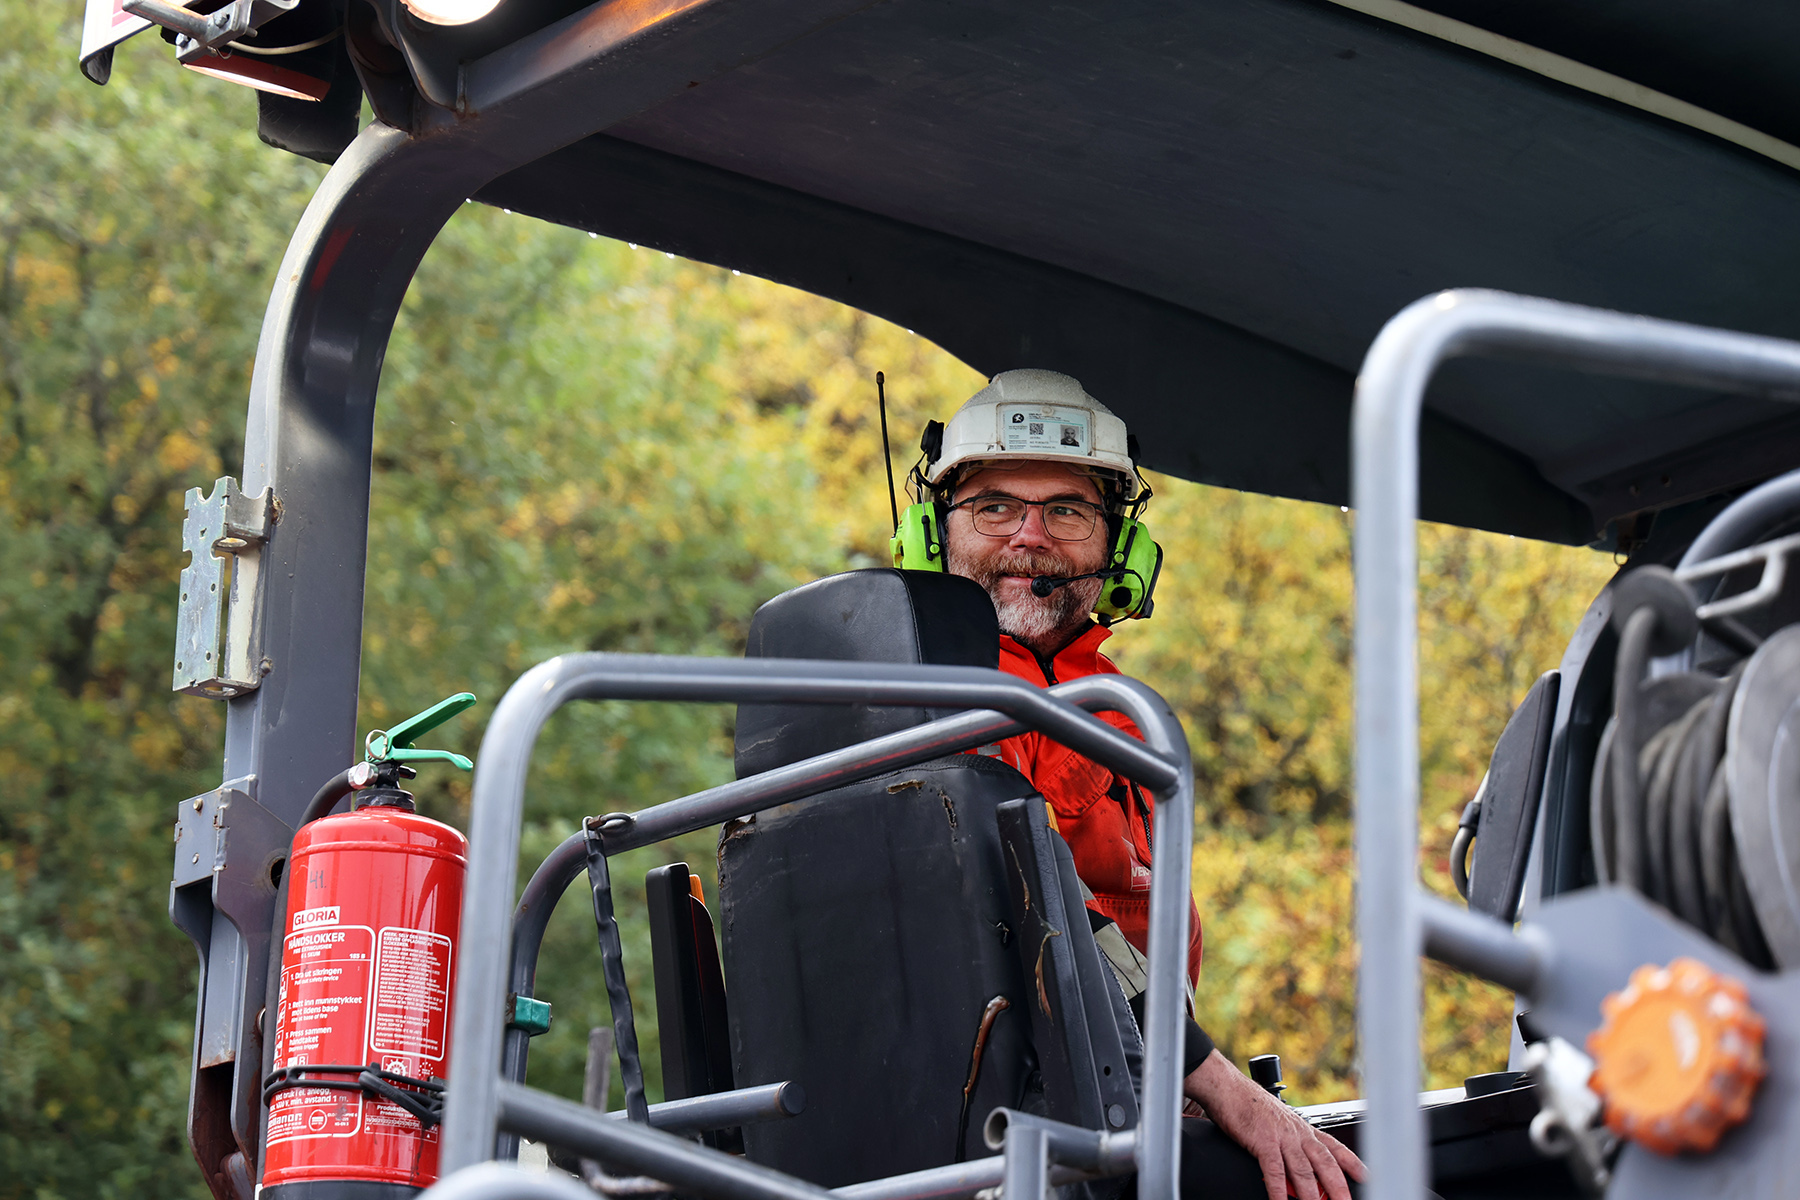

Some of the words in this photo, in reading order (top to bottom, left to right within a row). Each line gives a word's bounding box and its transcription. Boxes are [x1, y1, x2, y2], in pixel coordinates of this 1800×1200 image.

[294, 910, 337, 926] GLORIA
[287, 932, 346, 950] HÅNDSLOKKER
[304, 970, 312, 978] ut
[312, 967, 343, 977] sikringen
[315, 996, 363, 1006] munnstykket
[321, 1005, 339, 1013] base
[290, 1030, 304, 1038] Press
[304, 1027, 333, 1036] sammen
[304, 1095, 332, 1105] avstand
